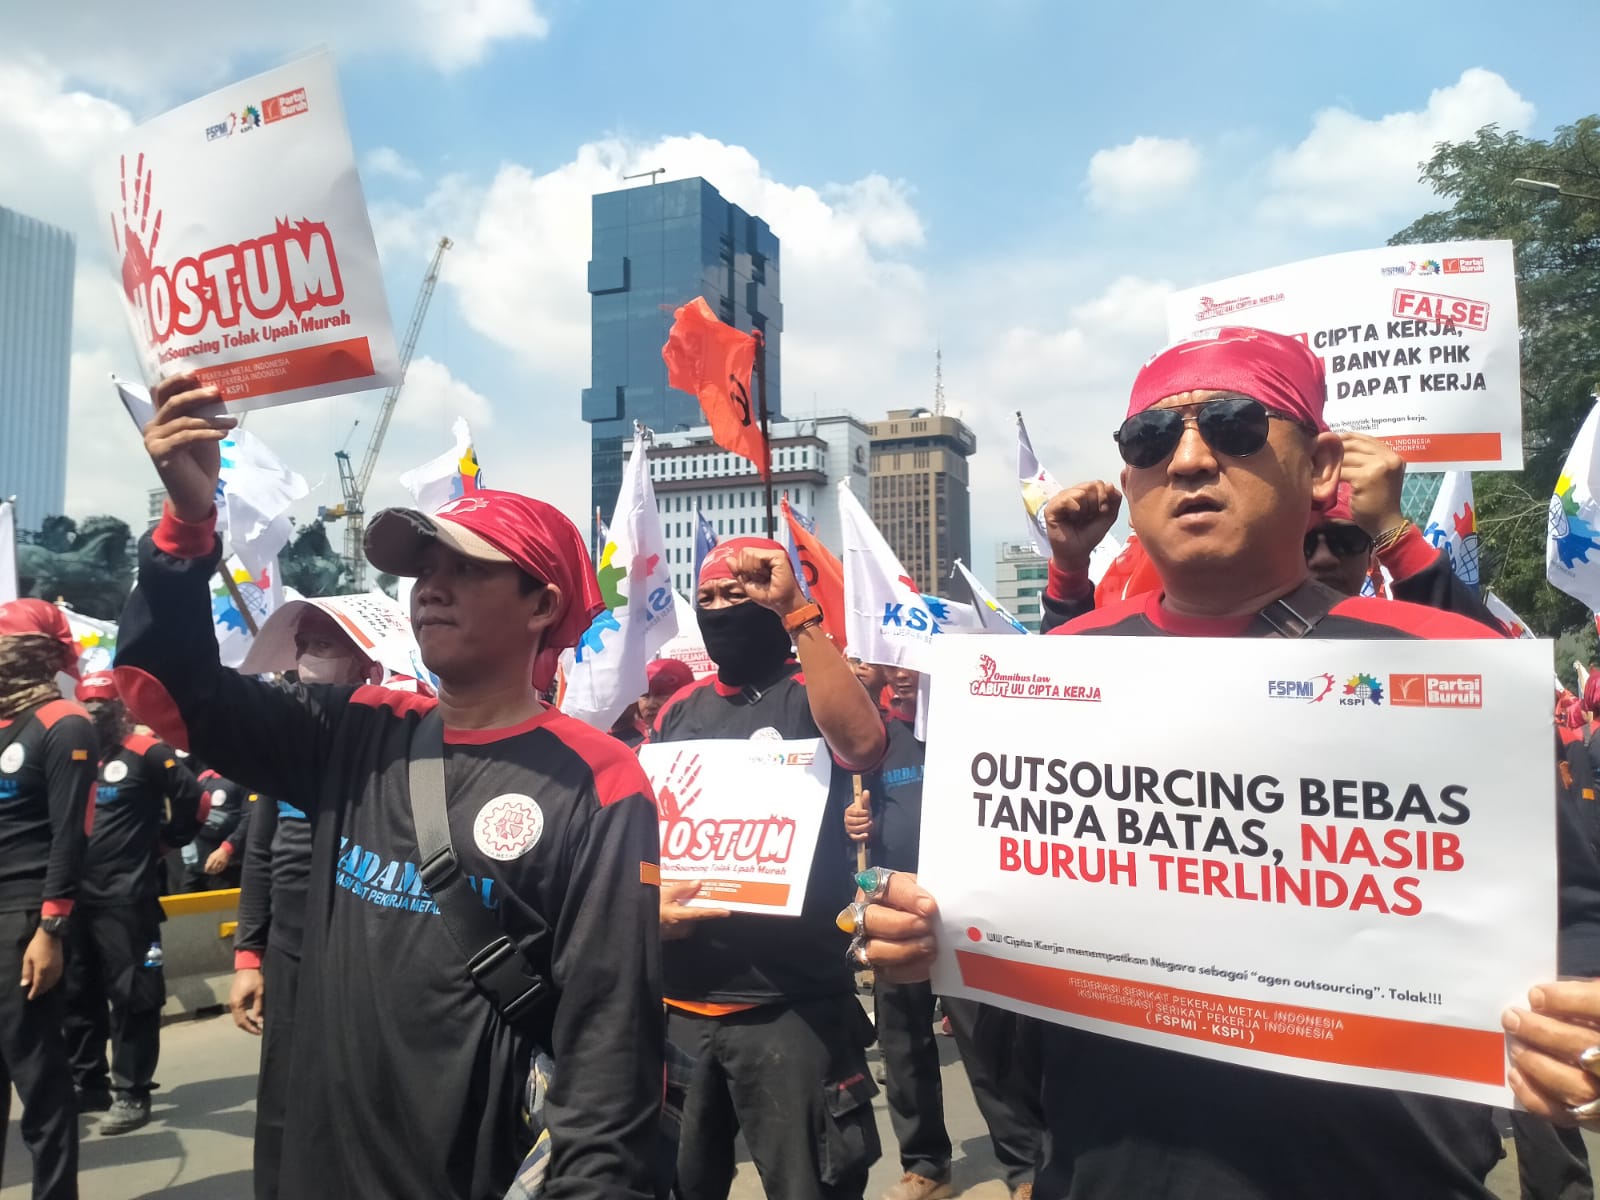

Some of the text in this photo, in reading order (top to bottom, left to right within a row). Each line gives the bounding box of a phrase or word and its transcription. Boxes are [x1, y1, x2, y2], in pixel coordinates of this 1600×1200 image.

[1397, 293, 1485, 326] FALSE
[222, 329, 260, 349] Tolak
[262, 320, 298, 342] Upah
[301, 309, 351, 334] Murah
[1313, 317, 1463, 349] CIPTA KERJA,
[1331, 344, 1471, 374] BANYAK PHK
[1336, 372, 1487, 401] DAPAT KERJA
[1395, 437, 1431, 445] INDONESIA
[969, 680, 1102, 699] CABUT UU CIPTA KERJA
[994, 673, 1051, 683] Omnibus Law
[1268, 680, 1314, 697] FSPMI
[1427, 678, 1480, 691] Partai
[1339, 698, 1366, 706] KSPI
[1427, 690, 1480, 705] Buruh
[971, 751, 1471, 826] OUTSOURCING BEBAS
[972, 791, 1465, 872] TANPA BATAS, NASIB
[999, 836, 1423, 917] BURUH TERLINDAS
[1003, 936, 1033, 949] Cipta
[1034, 940, 1065, 955] Kerja
[1150, 956, 1197, 973] Negara
[1198, 964, 1249, 982] sebagai
[1389, 987, 1443, 1006] Tolak!!!
[1068, 976, 1345, 1031] FEDERASI SERIKAT PEKERJA METAL INDONESIA
[1078, 989, 1335, 1042] KONFEDERASI SERIKAT PEKERJA INDONESIA
[1155, 1013, 1198, 1032] FSPMI
[1211, 1024, 1245, 1041] KSPI
